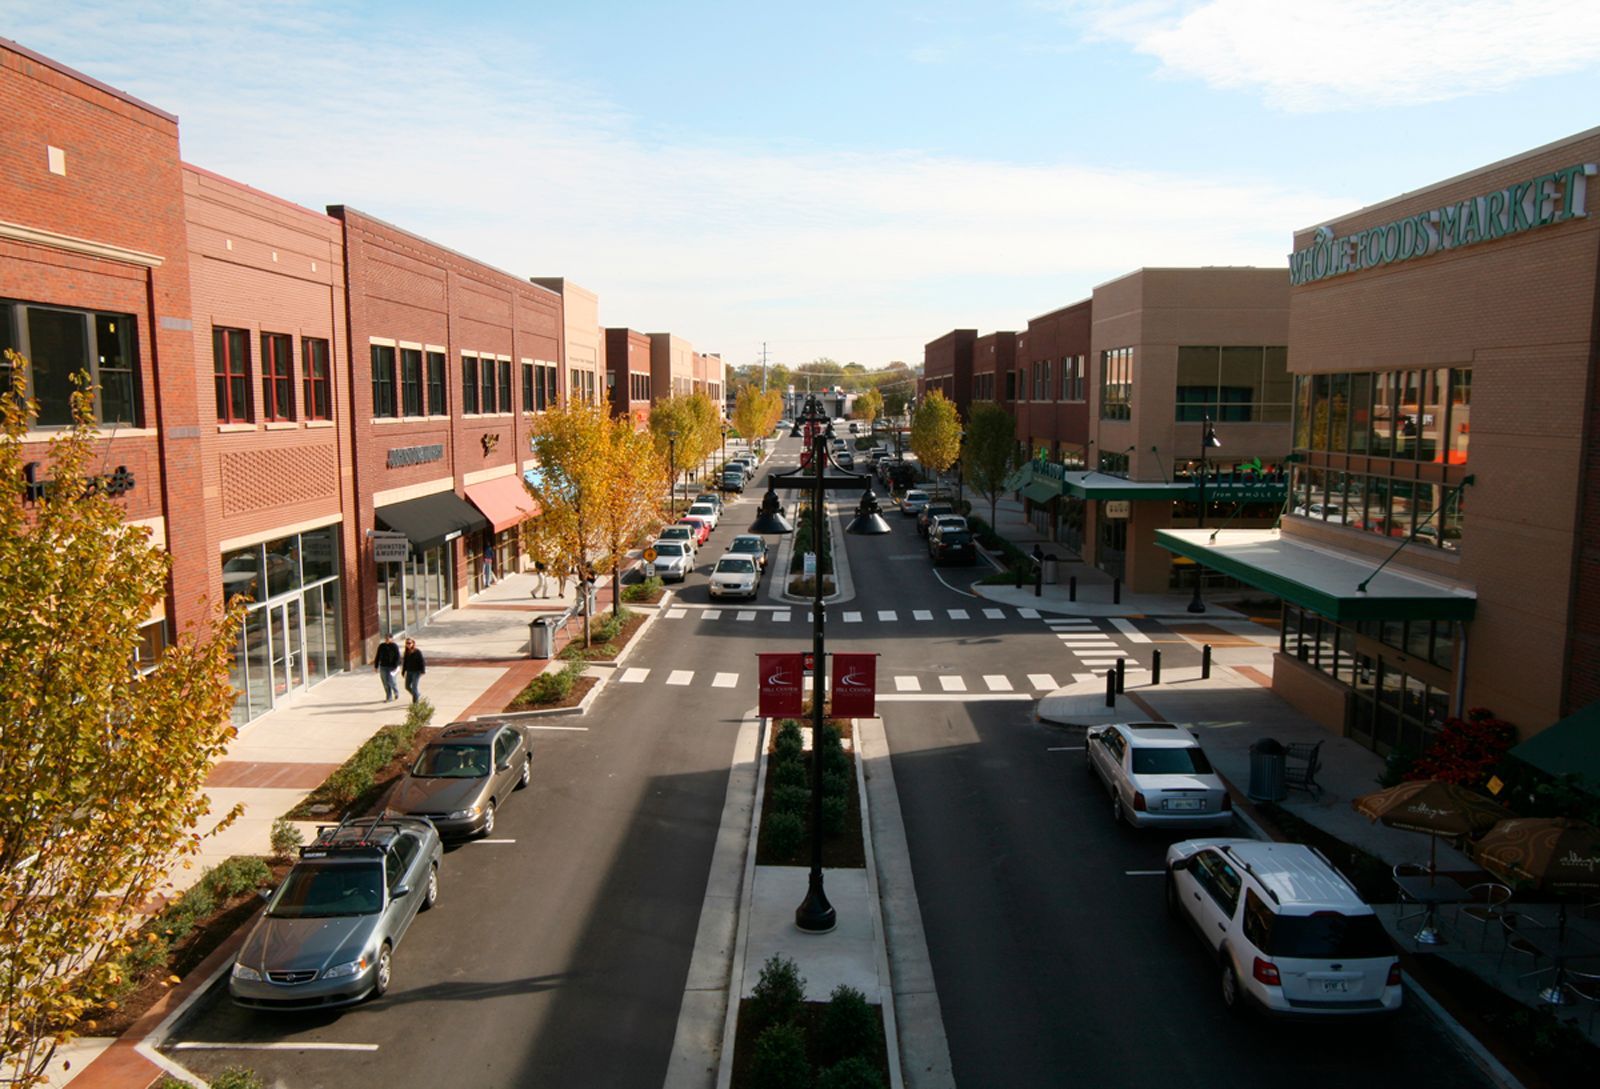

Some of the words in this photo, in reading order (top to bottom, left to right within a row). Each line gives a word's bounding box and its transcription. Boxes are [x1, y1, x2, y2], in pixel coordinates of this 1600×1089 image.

[1288, 227, 1352, 286] WHOLE
[1356, 211, 1434, 270] FOODS
[1437, 163, 1595, 251] MARKET
